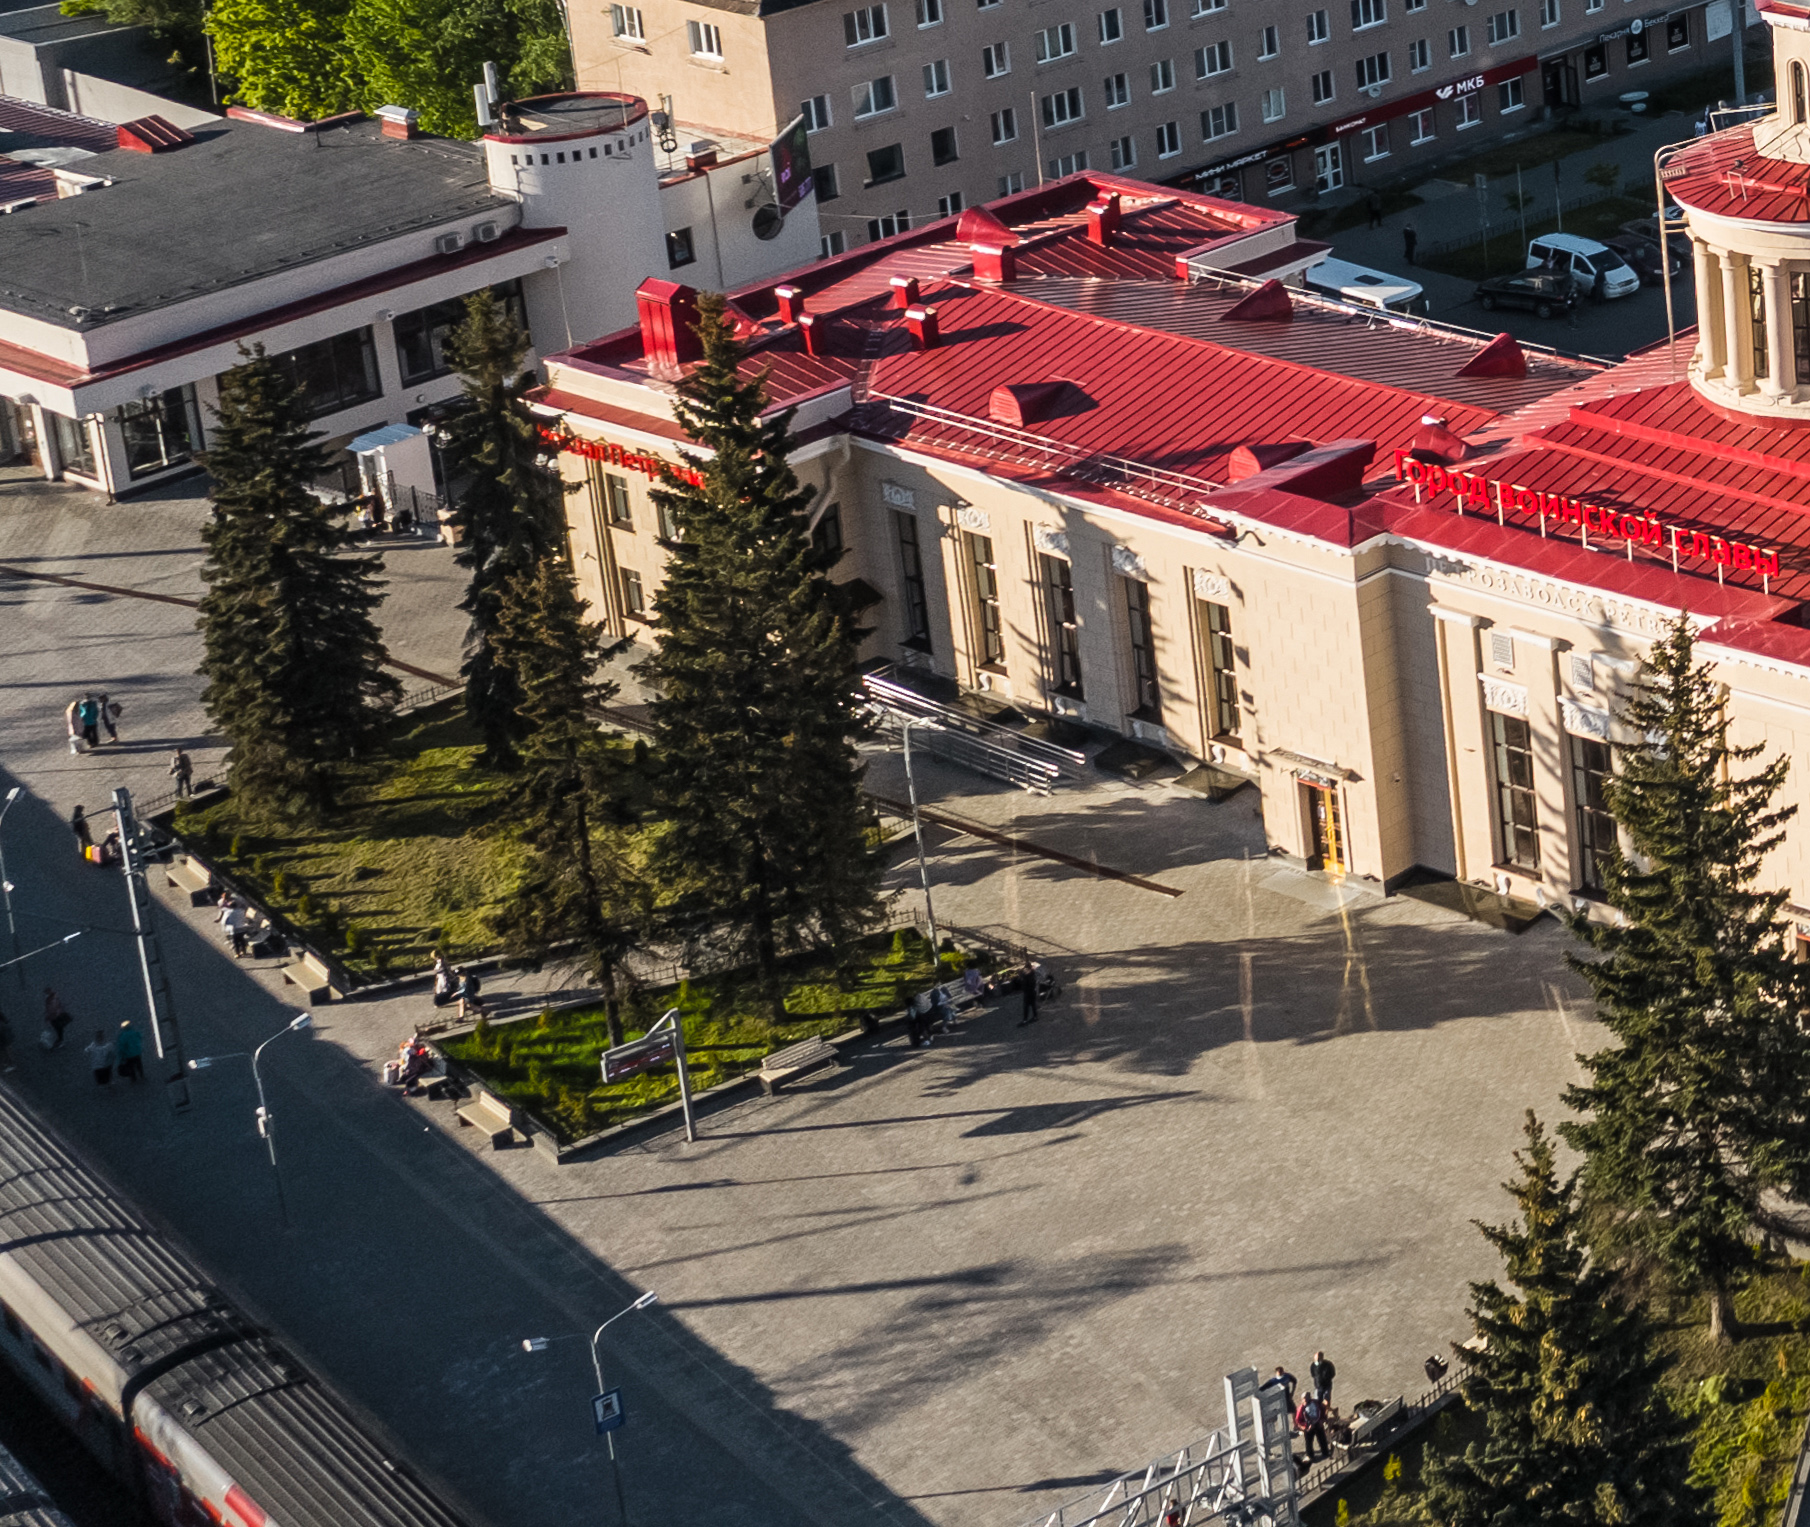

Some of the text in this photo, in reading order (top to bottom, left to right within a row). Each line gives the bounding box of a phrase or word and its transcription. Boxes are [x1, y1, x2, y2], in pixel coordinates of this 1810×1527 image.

[1599, 14, 1669, 43] Пекарня Беккер
[1456, 74, 1485, 95] МКБ
[1195, 165, 1225, 181] МИНИ
[1226, 149, 1268, 170] МАРКЕТ
[1393, 449, 1780, 578] Город воинской славы
[1425, 557, 1596, 614] ПЕТРОЗАВОДСК
